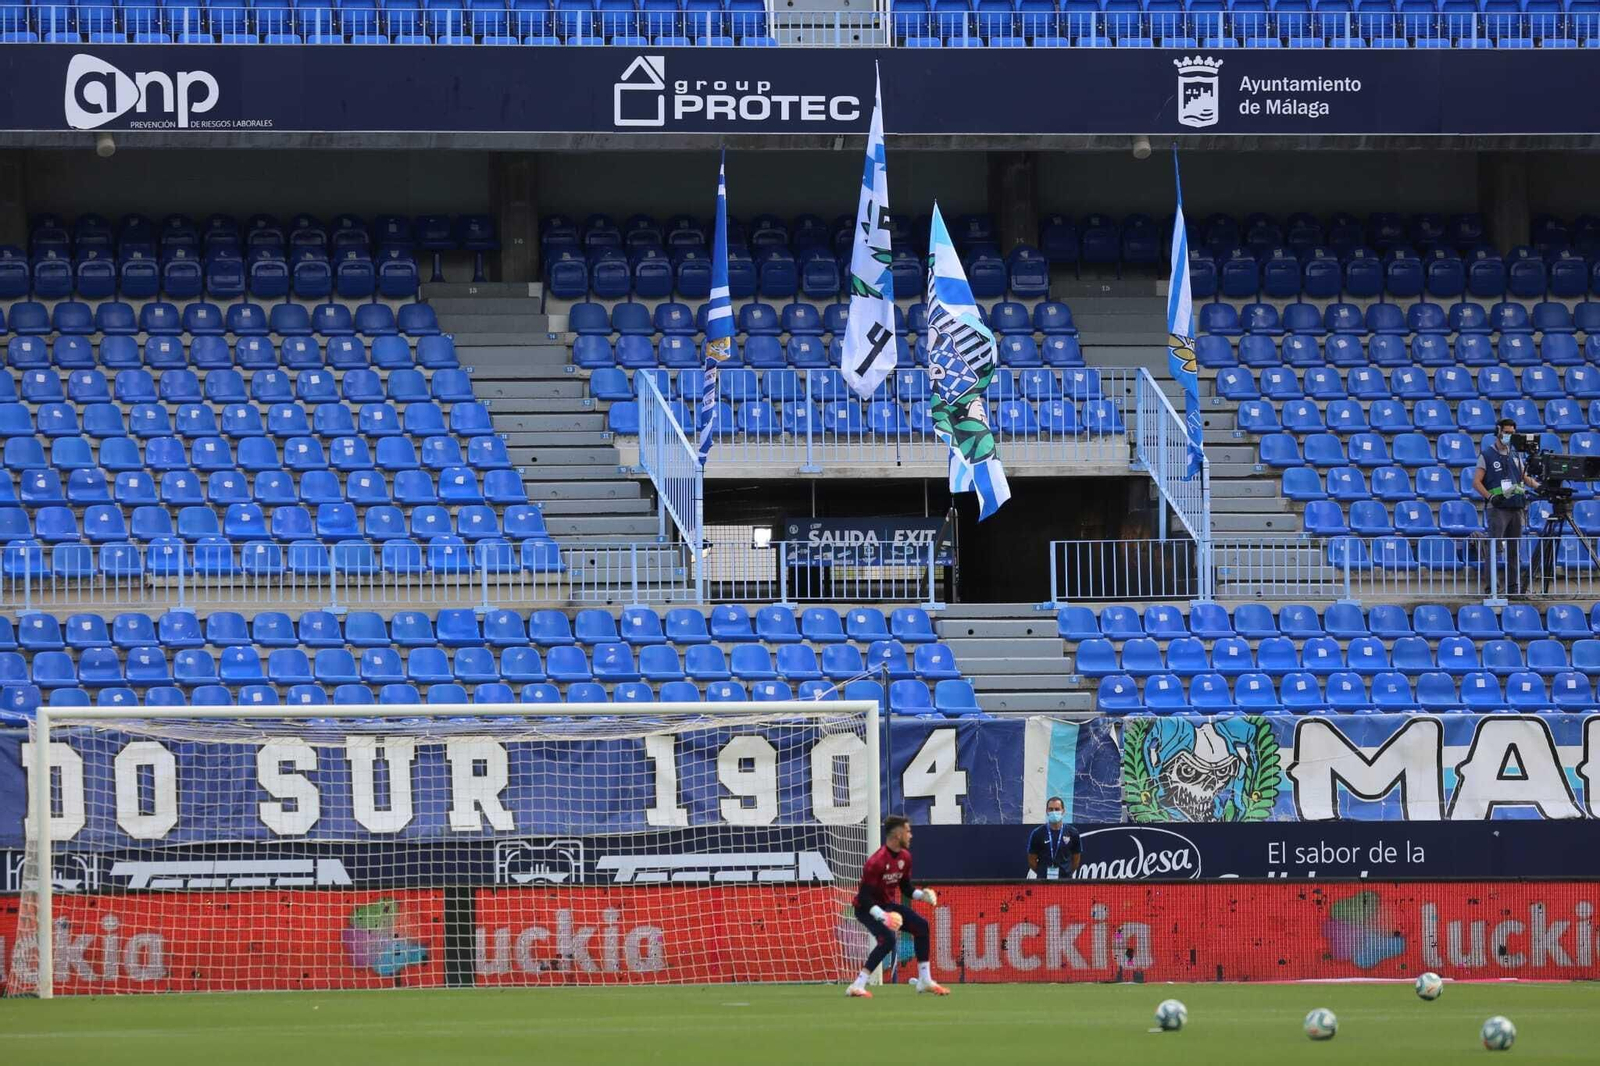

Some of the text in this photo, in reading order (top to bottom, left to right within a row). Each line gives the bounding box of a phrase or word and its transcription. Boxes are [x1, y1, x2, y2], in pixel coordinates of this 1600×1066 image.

[674, 80, 771, 94] group
[1239, 76, 1362, 95] Ayuntamiento
[674, 95, 860, 121] PROTEC
[1239, 98, 1330, 118] de Málaga
[130, 119, 273, 129] PREVENCIÓN DE RIESGOS LABORALES
[808, 530, 879, 547] SALIDA
[893, 530, 936, 547] EXIT
[1285, 714, 1600, 822] MA
[22, 727, 969, 841] DO SUR 1904
[1072, 834, 1193, 879] madesa
[1268, 840, 1425, 864] El sabor de la
[933, 903, 1155, 971] luckia
[1421, 900, 1600, 968] lucki
